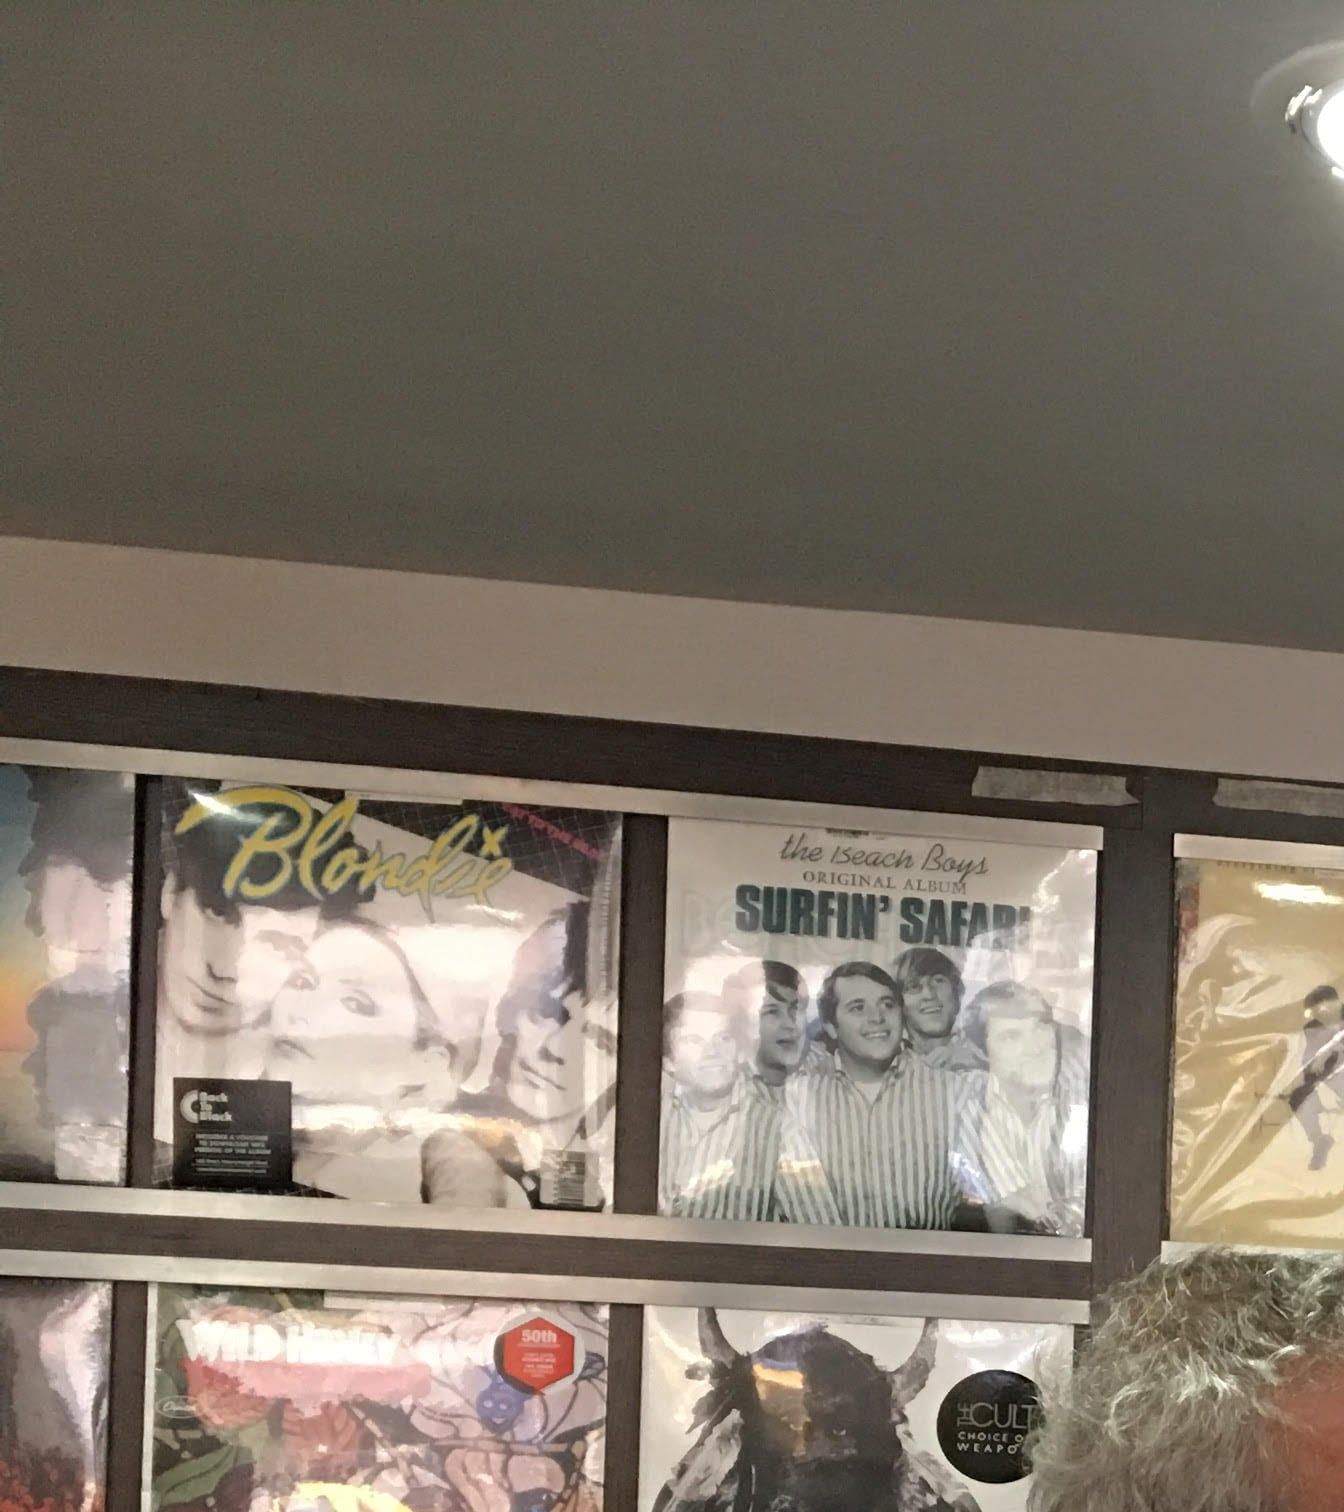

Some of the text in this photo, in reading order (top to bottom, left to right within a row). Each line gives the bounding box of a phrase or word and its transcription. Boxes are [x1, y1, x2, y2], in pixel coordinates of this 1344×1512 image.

[175, 785, 515, 922] Blondie
[780, 833, 989, 876] the Beach Boys
[803, 870, 967, 895] ORIGINAL ALBUM
[735, 884, 890, 940] SURFIN'
[521, 1329, 558, 1343] 50th
[969, 1402, 1038, 1431] CULT
[957, 1442, 1018, 1455] WEAPO
[958, 1431, 1024, 1443] CHOICE O
